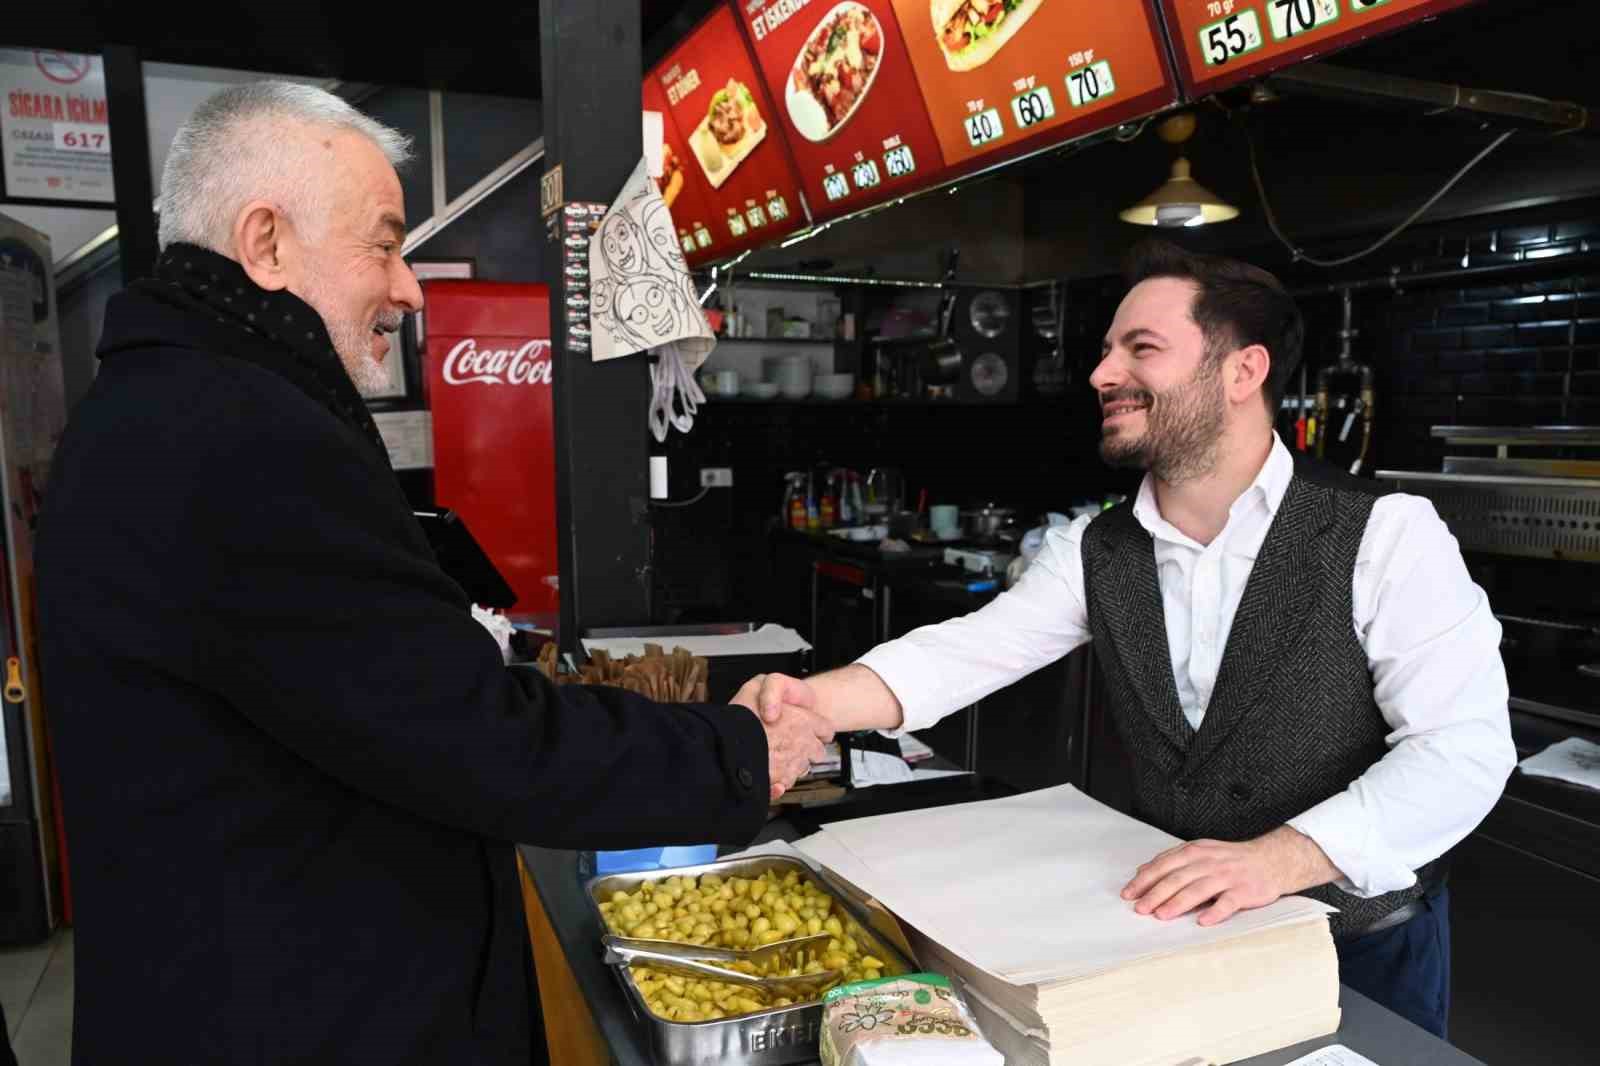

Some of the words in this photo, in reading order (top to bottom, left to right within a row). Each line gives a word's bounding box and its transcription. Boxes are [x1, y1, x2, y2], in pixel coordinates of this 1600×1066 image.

[1207, 2, 1222, 17] 70
[1275, 0, 1316, 38] 70
[1208, 15, 1246, 65] 55
[1071, 67, 1099, 105] 70
[9, 87, 64, 121] SİGARA
[1019, 92, 1045, 125] 60
[63, 131, 105, 148] 617
[972, 115, 993, 144] 40
